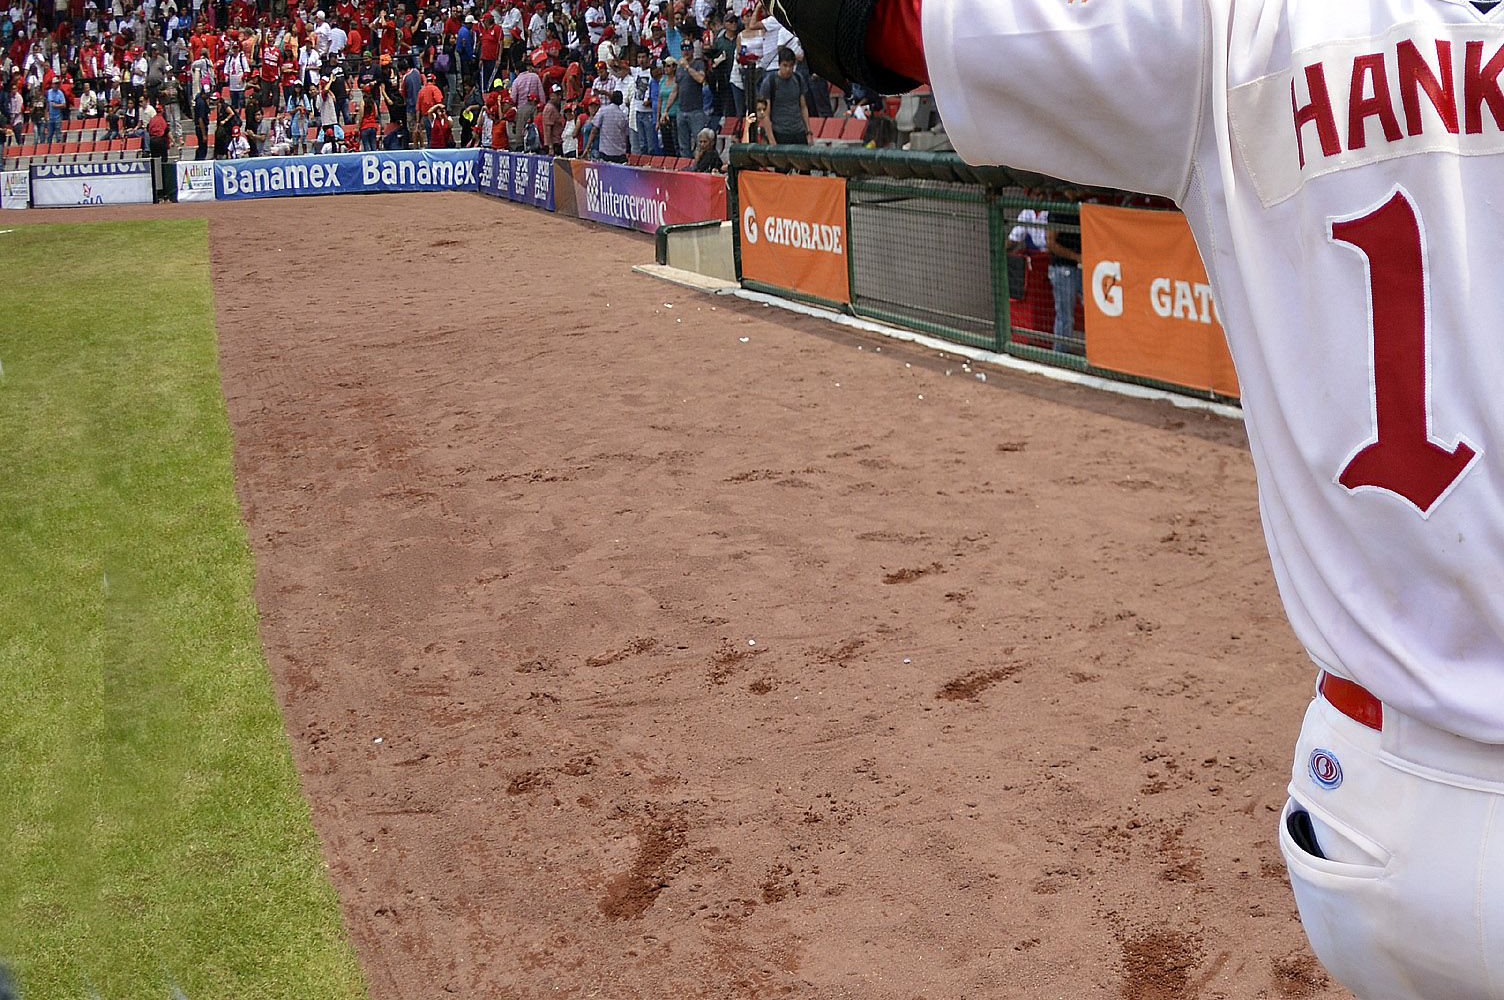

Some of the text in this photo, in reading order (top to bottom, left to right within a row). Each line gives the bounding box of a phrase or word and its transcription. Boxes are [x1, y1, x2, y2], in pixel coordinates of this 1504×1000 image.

[222, 163, 341, 195] Banamex
[361, 155, 476, 187] Banamex
[599, 180, 667, 226] Interceramic
[743, 206, 842, 254] G GATORADE
[1092, 261, 1124, 317] G
